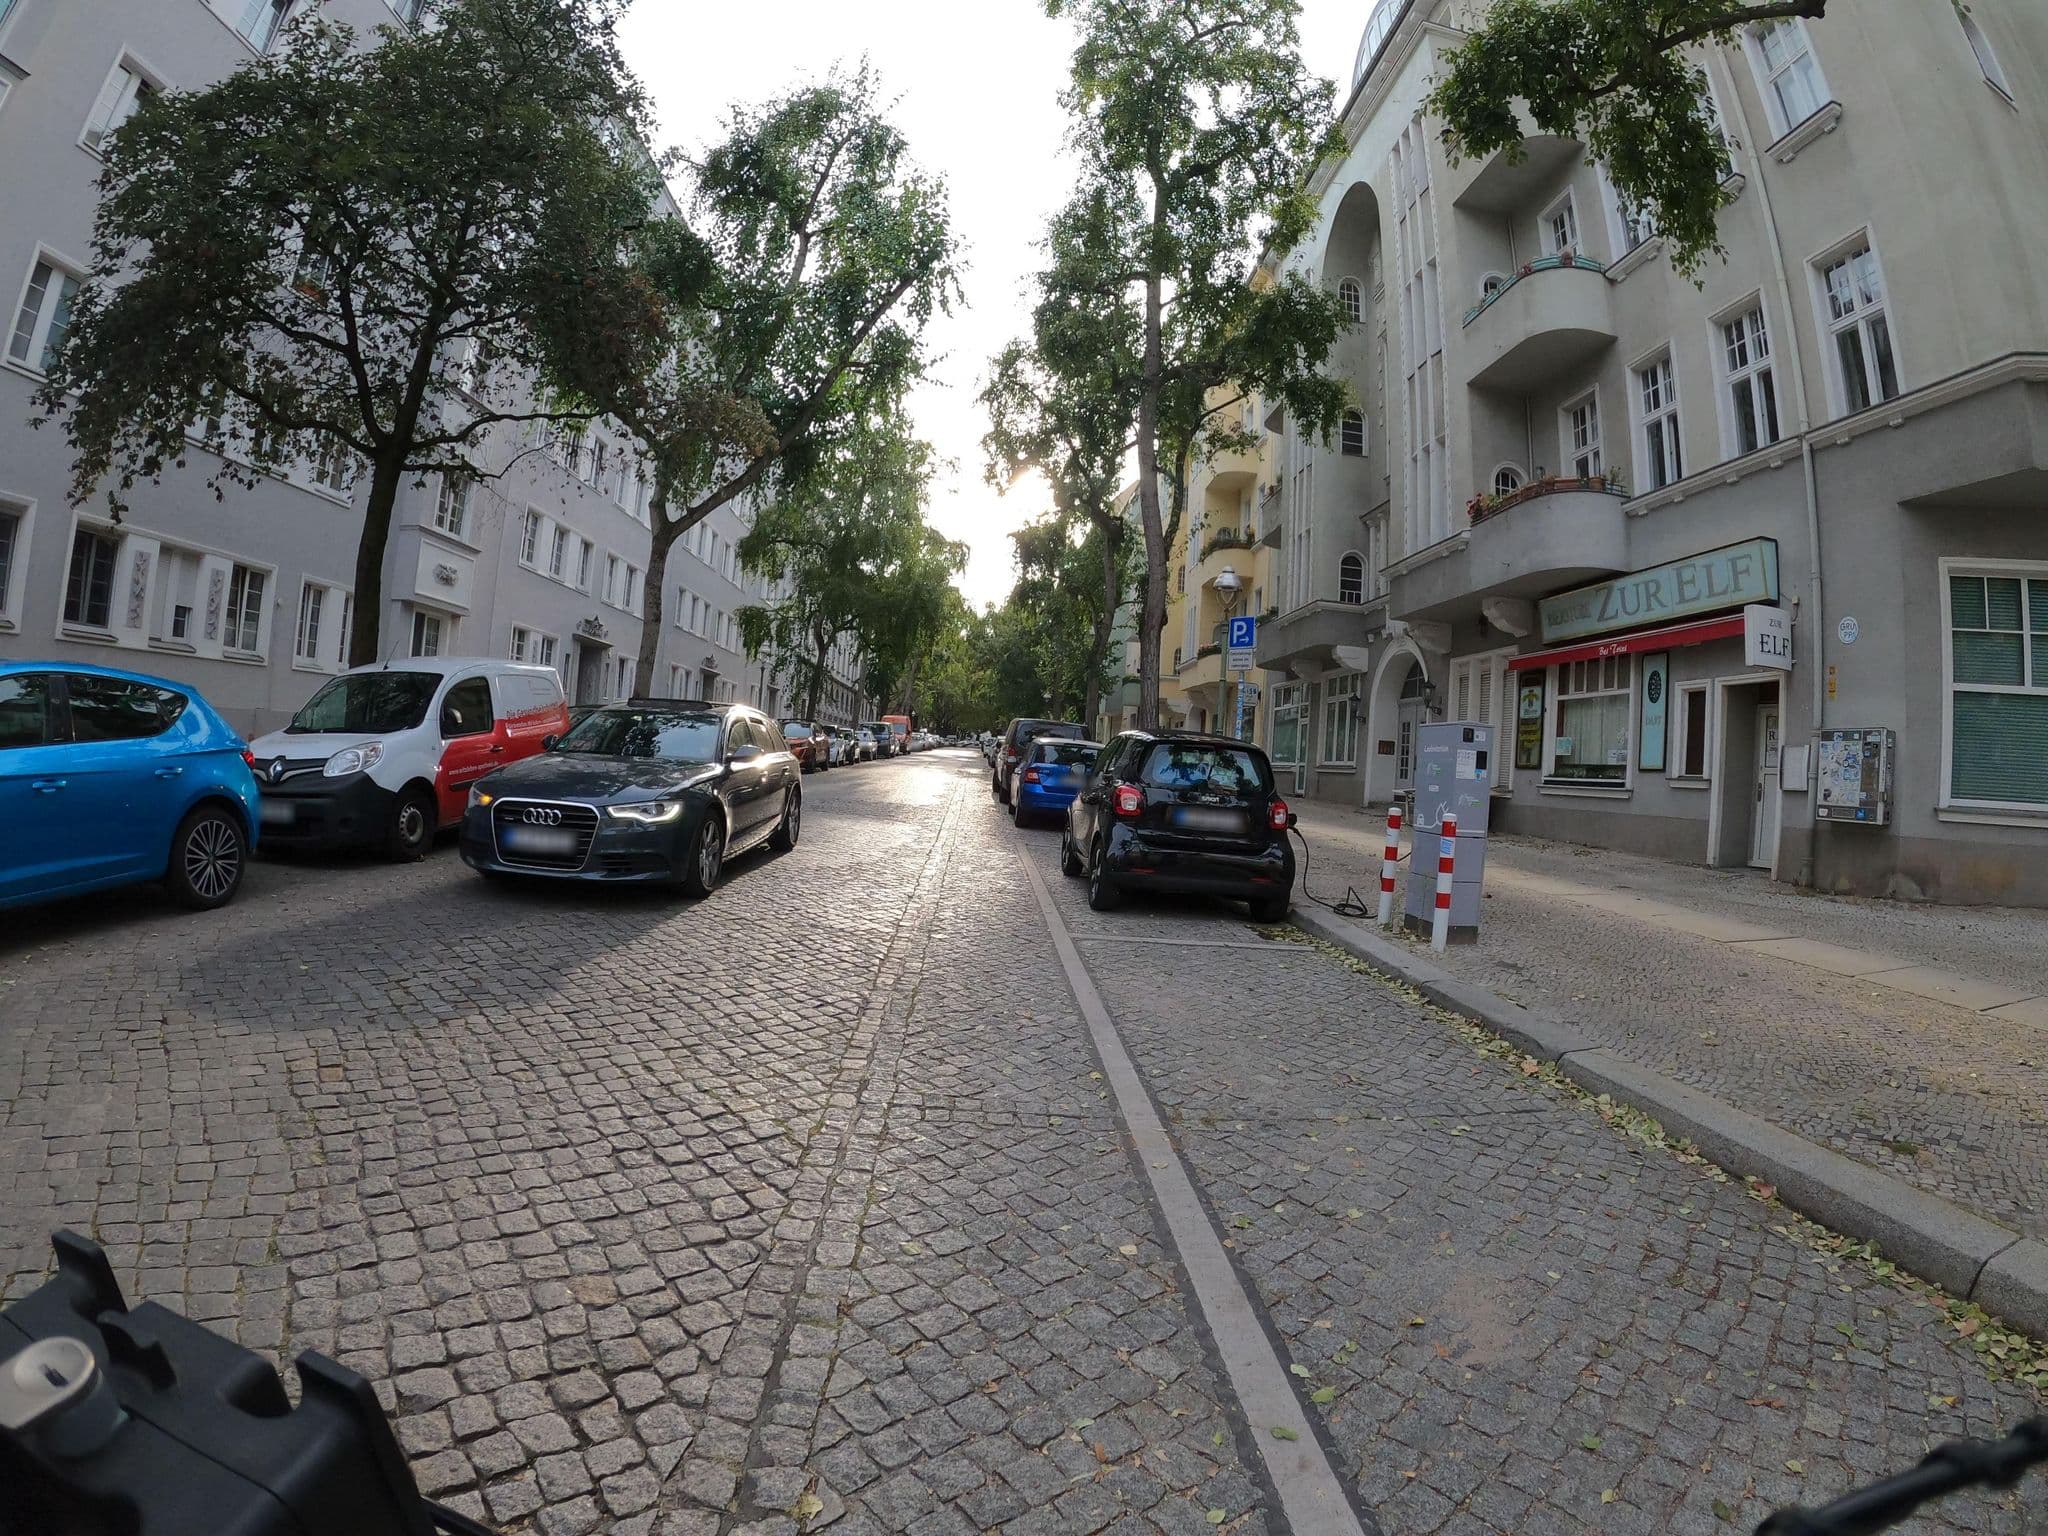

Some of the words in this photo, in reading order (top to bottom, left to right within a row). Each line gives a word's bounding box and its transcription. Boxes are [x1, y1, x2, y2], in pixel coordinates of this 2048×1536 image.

[1595, 579, 1667, 623] ZUR
[1672, 553, 1754, 605] ELF
[1232, 620, 1248, 645] P
[1769, 618, 1783, 629] ZUR
[1760, 633, 1790, 658] ELF
